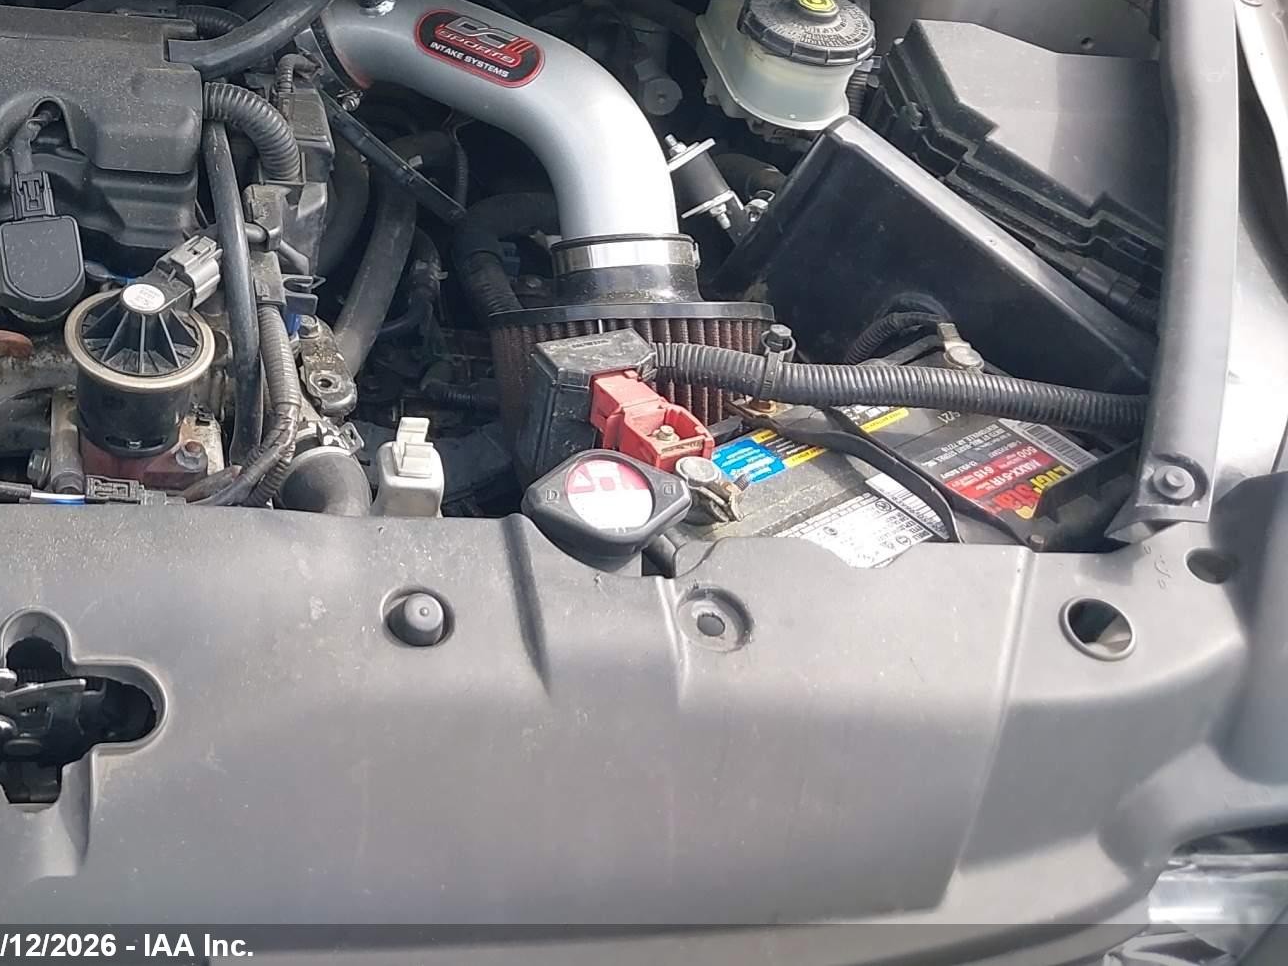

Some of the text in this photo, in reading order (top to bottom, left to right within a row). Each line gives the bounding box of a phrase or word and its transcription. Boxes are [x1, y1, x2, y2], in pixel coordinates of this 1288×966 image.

[430, 41, 510, 79] INTAKE SYSTEMS
[438, 29, 516, 65] SPORTS
[973, 466, 995, 479] 615
